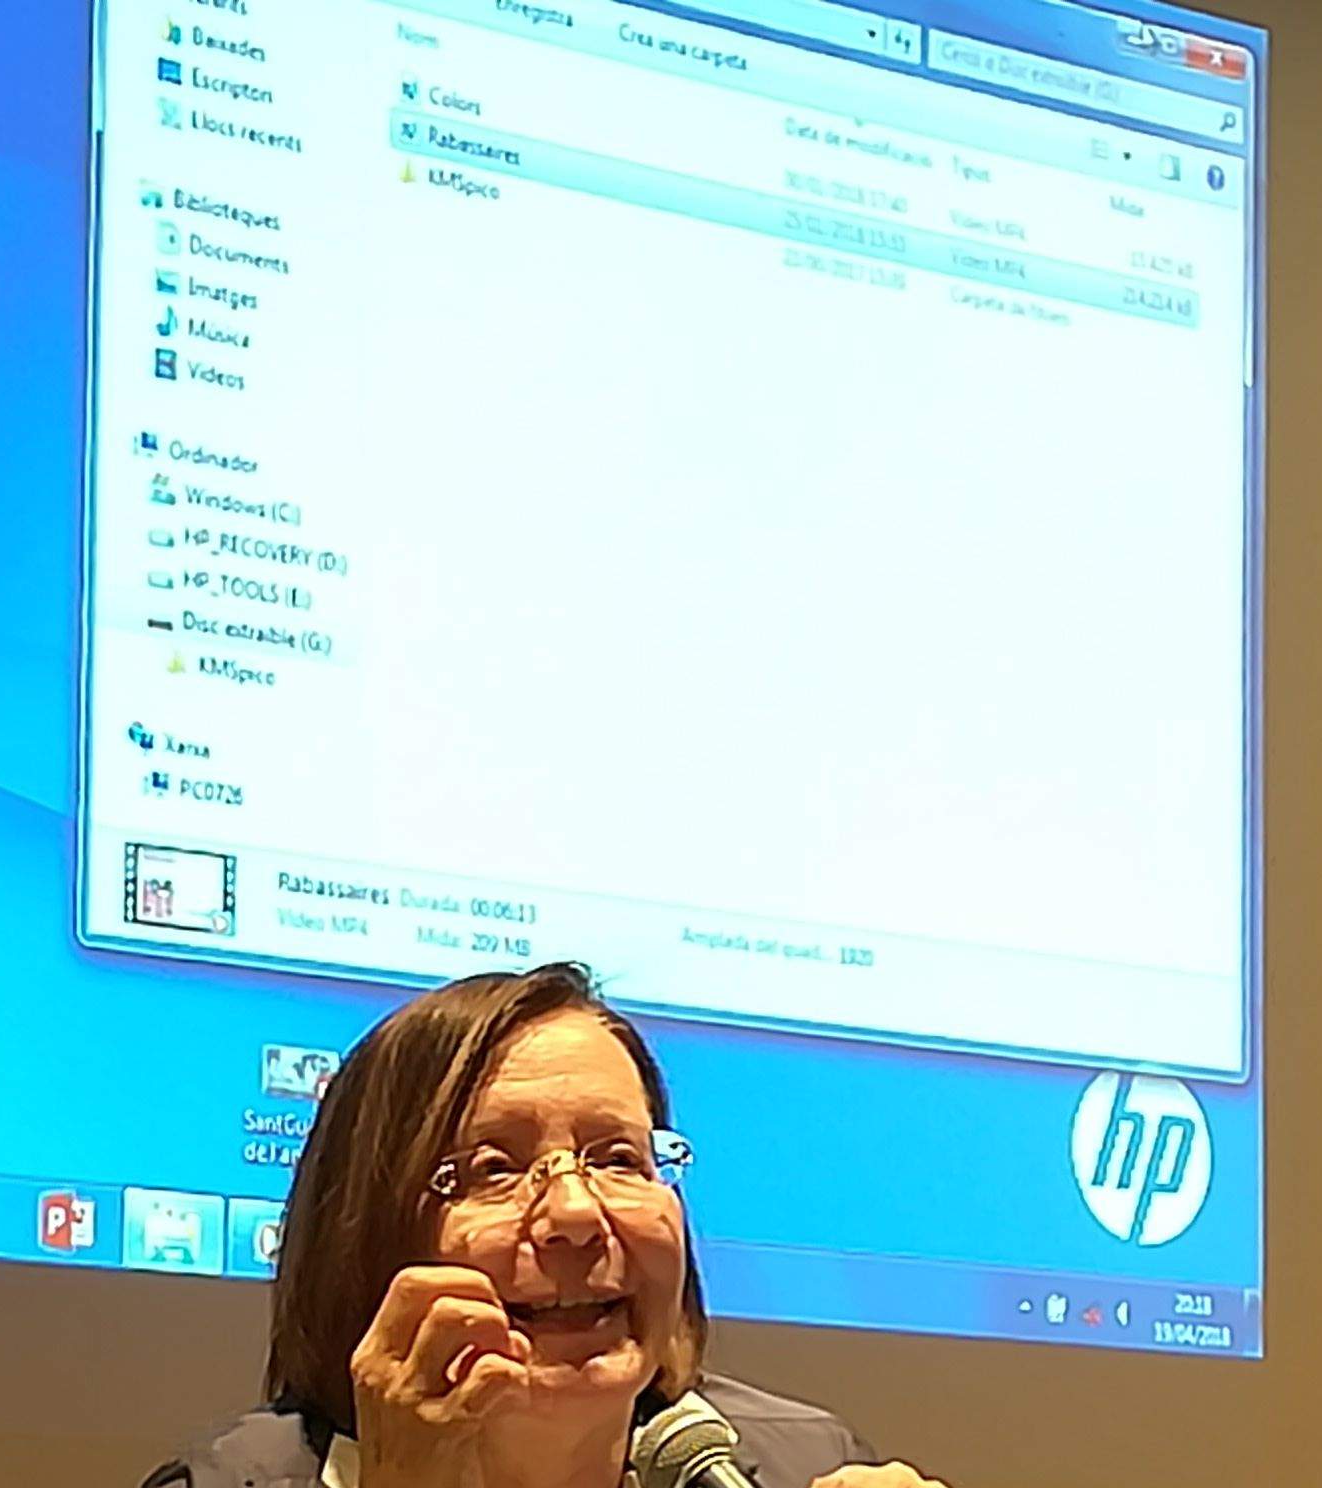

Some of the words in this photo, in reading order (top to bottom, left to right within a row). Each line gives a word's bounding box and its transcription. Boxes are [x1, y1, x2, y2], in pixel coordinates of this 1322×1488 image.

[189, 234, 289, 274] Documents
[189, 277, 258, 310] Imatges
[170, 441, 258, 473] Ordinador
[185, 485, 266, 518] Windows
[183, 610, 218, 635] Disc
[278, 872, 389, 905] Rabassaires
[1091, 1072, 1195, 1245] hp
